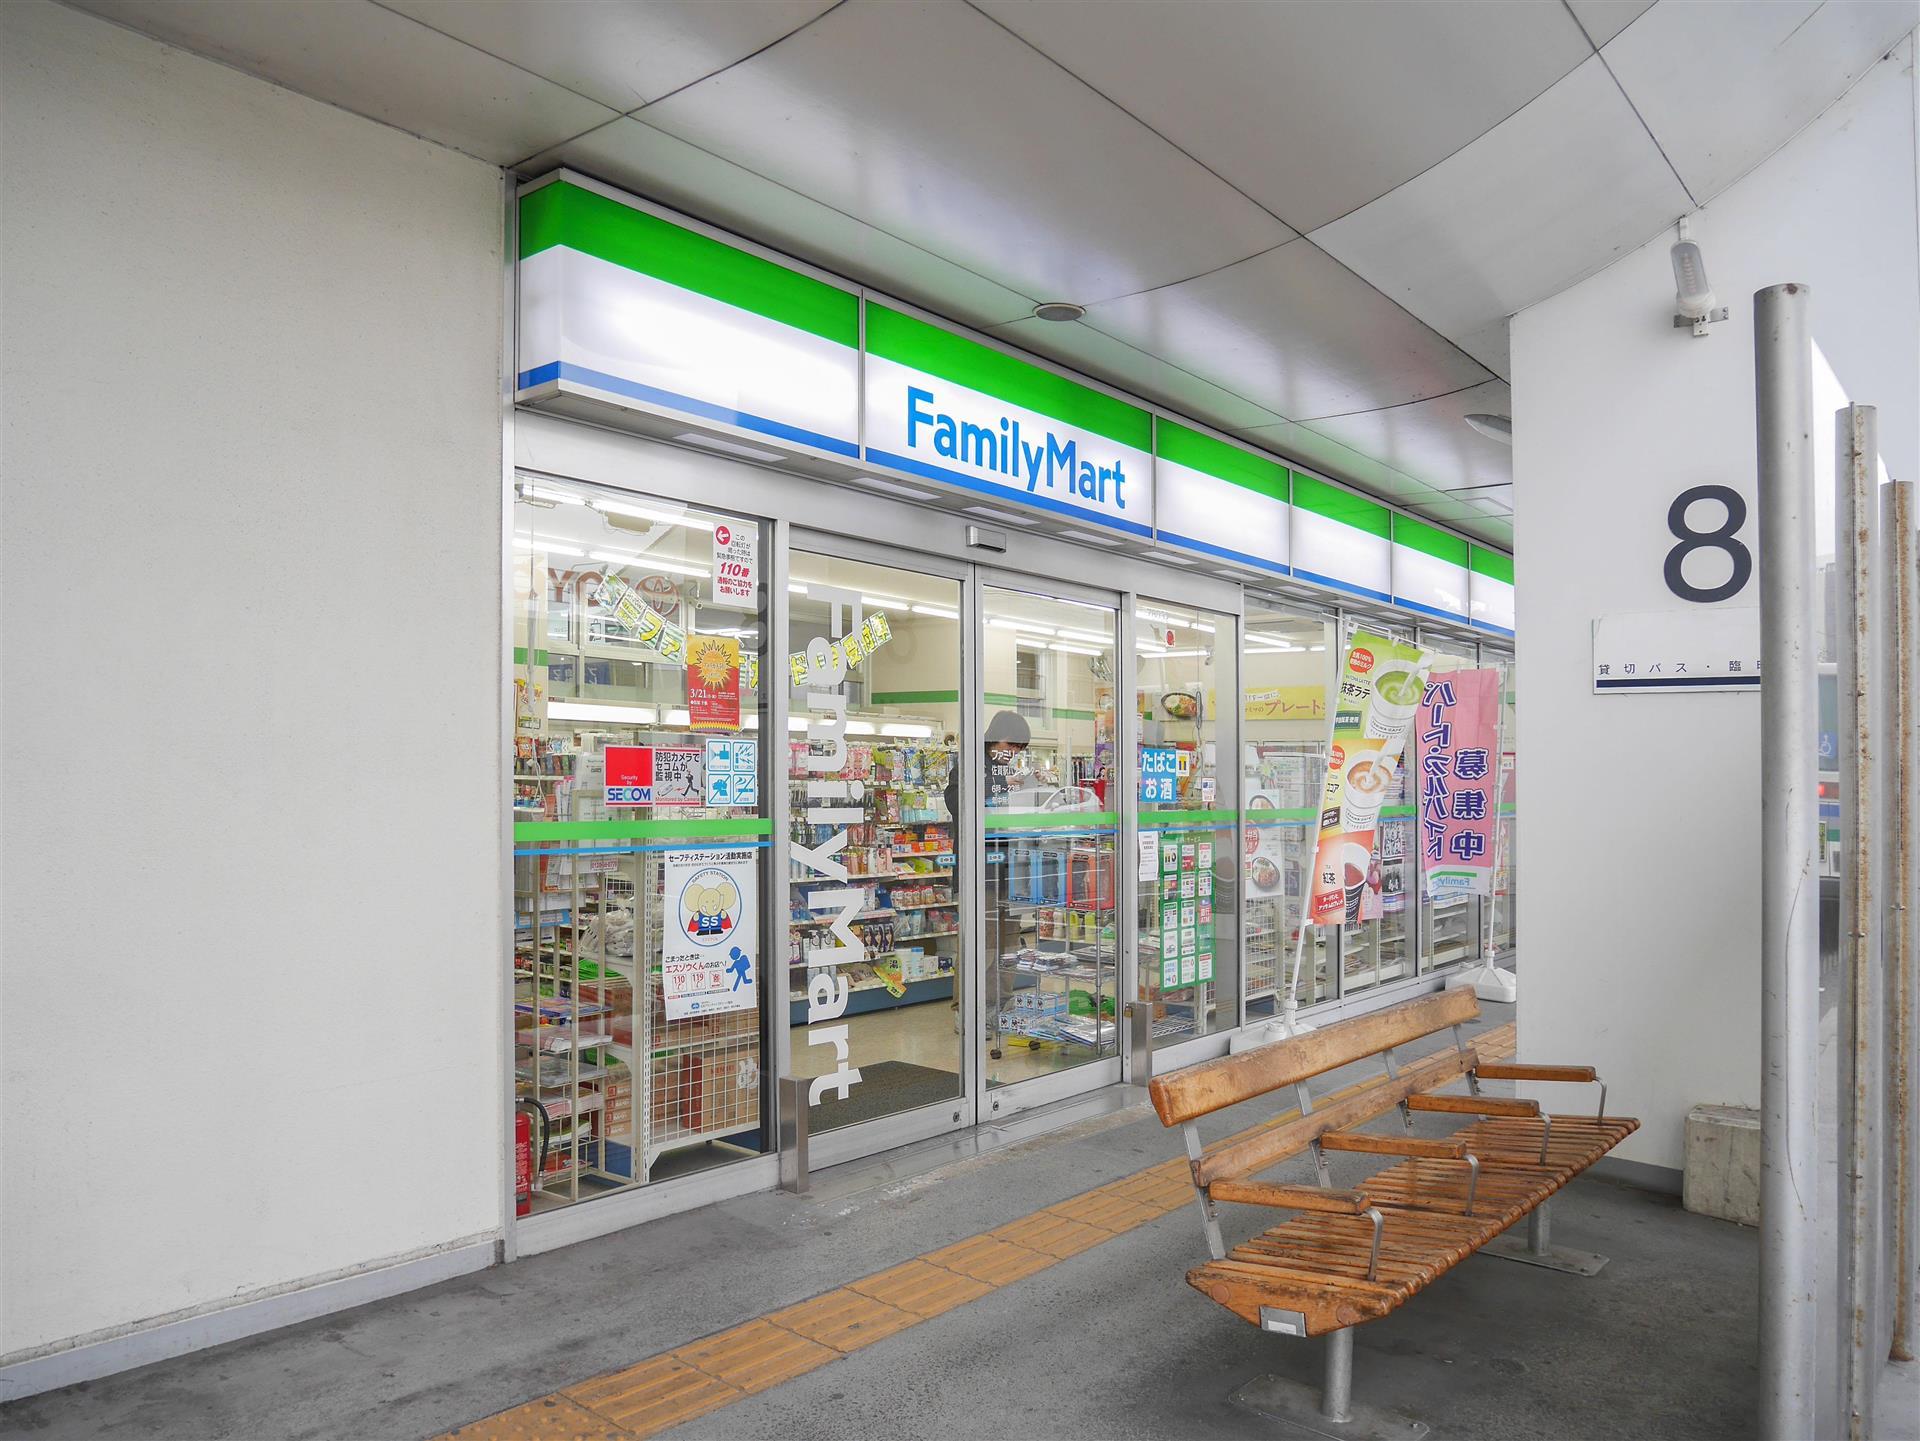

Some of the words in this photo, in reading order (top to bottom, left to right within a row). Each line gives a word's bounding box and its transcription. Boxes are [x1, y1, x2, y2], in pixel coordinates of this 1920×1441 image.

[908, 386, 1126, 509] FamilyMart
[1664, 484, 1752, 603] 8
[721, 562, 750, 578] 110番
[717, 576, 753, 589] 通報のご協力を
[720, 586, 752, 597] お願いします
[690, 688, 707, 699] 3/21
[655, 752, 700, 763] 防犯カメラで
[1142, 751, 1176, 774] たばこ
[655, 762, 688, 772] セコムが
[620, 774, 638, 782] Security
[655, 771, 682, 782] 監視中
[607, 787, 651, 802] SECOM
[1145, 778, 1173, 800] お酒
[791, 582, 864, 1106] FamilyMart
[691, 870, 710, 884] SAFETY
[710, 869, 730, 883] STATION
[1322, 871, 1336, 885] 紅茶
[701, 915, 719, 928] SS
[673, 974, 686, 984] 110
[692, 971, 704, 982] 119
